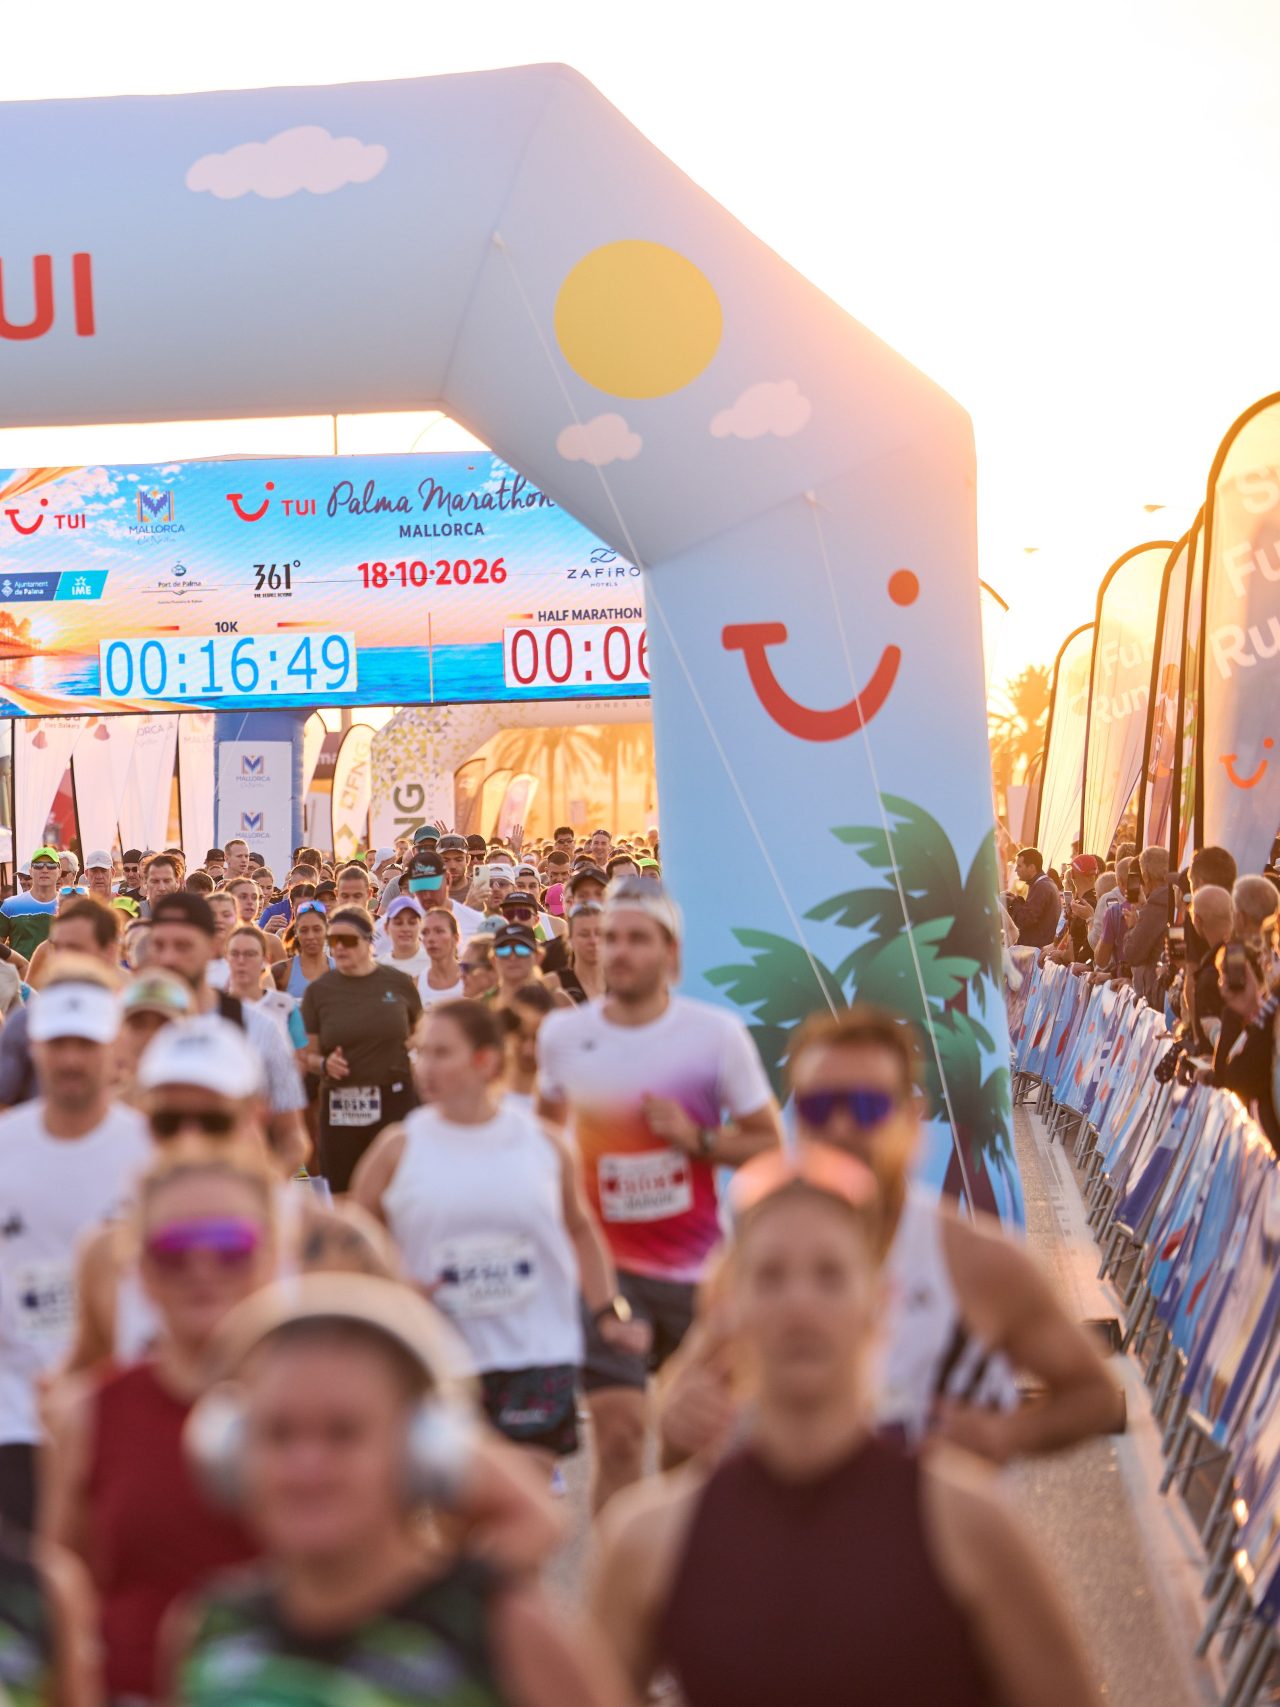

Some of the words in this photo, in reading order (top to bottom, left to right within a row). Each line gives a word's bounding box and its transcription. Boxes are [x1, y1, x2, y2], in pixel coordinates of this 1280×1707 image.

[281, 499, 316, 517] TUI
[327, 479, 413, 518] Palma
[418, 473, 556, 517] Marathon
[54, 514, 86, 530] TUI
[129, 524, 185, 535] MALLORCA
[399, 522, 485, 539] MALLORCA
[14, 581, 49, 589] Ajuntament
[71, 585, 92, 596] IME
[538, 610, 569, 622] HALF
[572, 607, 642, 621] MARATHON
[215, 621, 238, 633] 10K
[105, 634, 350, 697] 00:16:49
